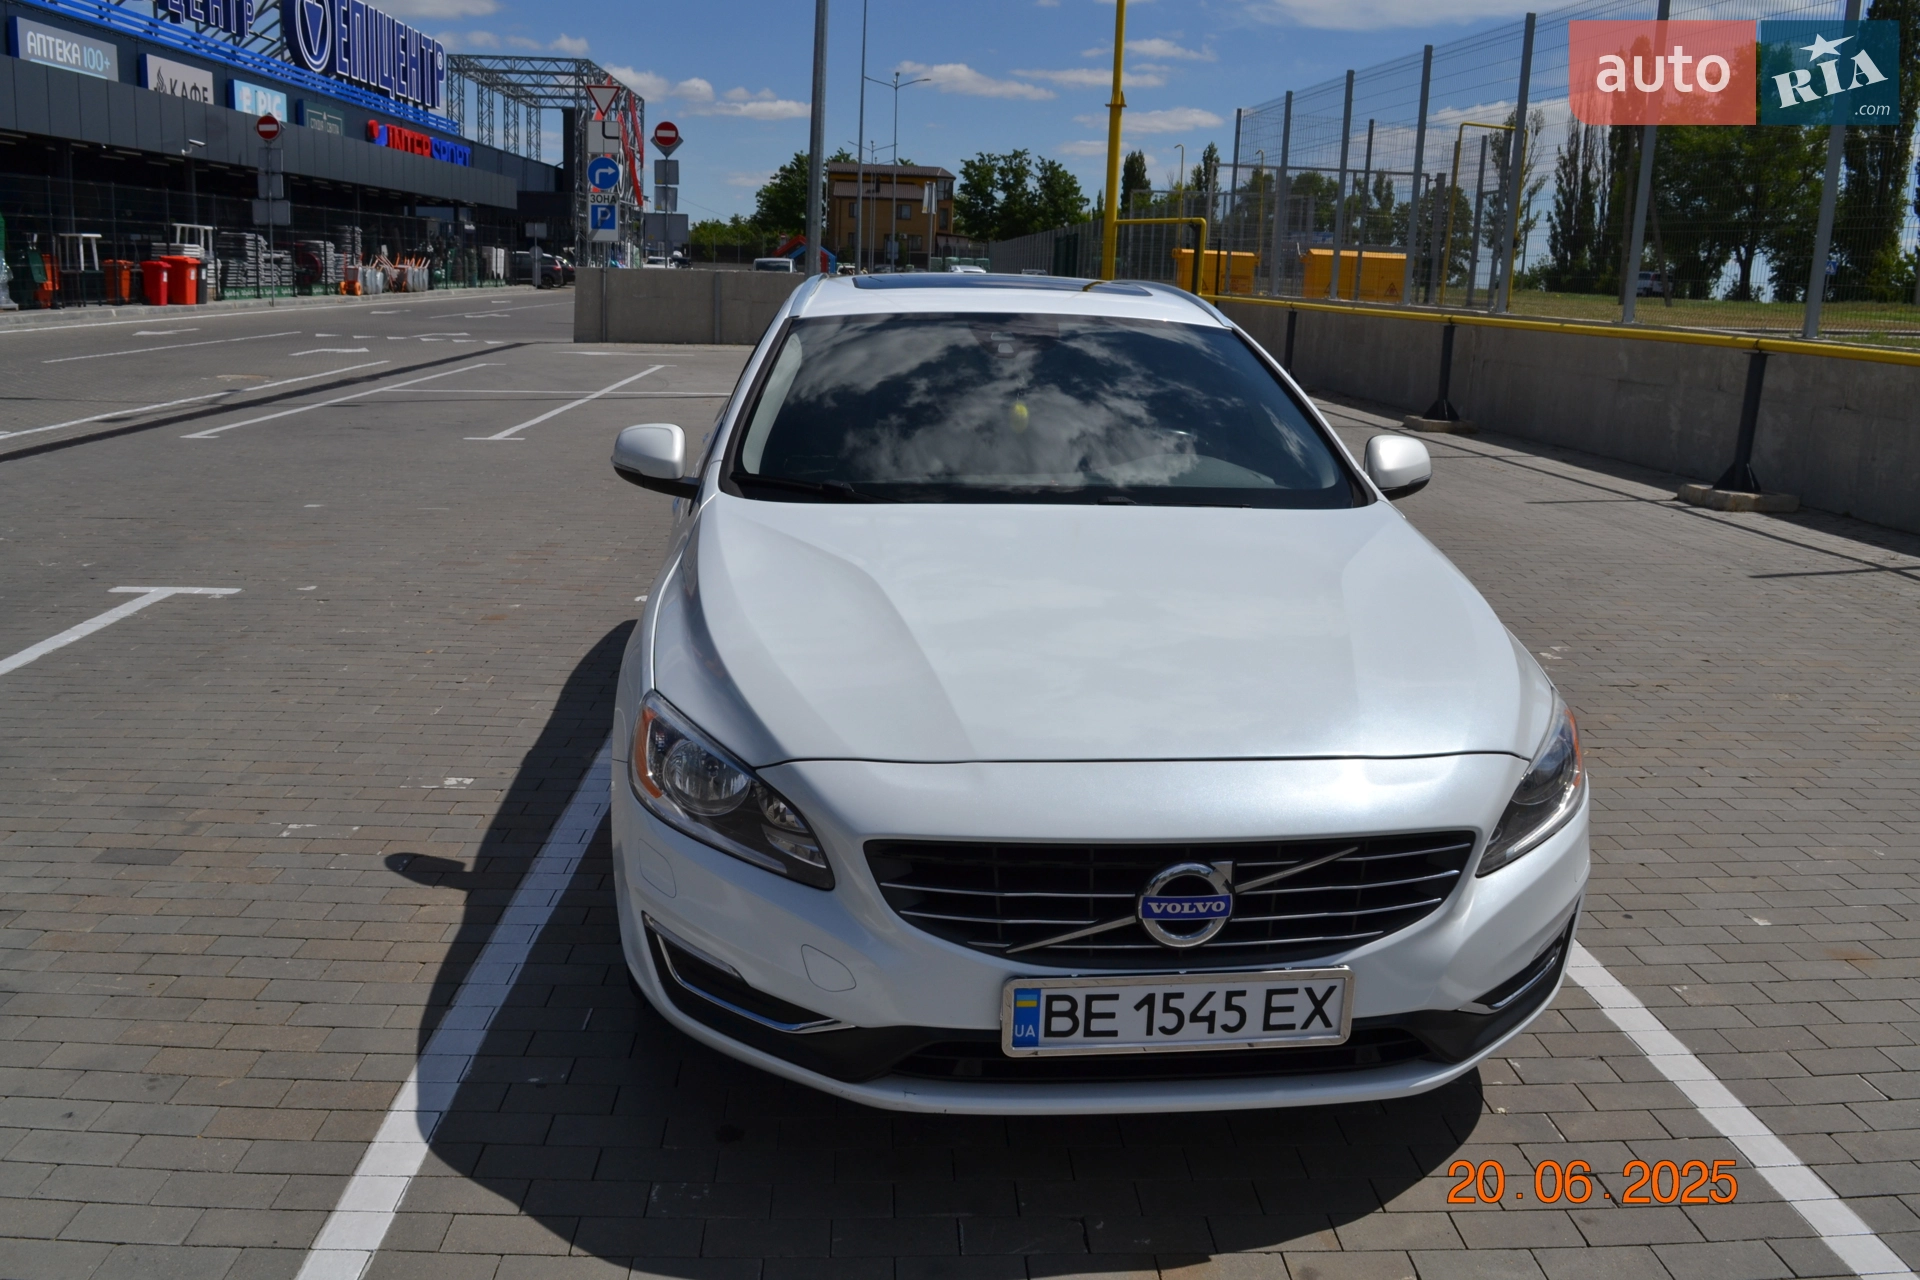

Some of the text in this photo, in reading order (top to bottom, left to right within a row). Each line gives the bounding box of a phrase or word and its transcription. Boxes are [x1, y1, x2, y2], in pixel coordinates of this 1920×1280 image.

[27, 31, 111, 72] АПТЕКА 100+
[335, 0, 446, 109] ЕПІЦЕНТР
[169, 77, 209, 103] КАФЕ
[590, 194, 617, 204] ЗОНА
[1148, 900, 1226, 914] VOLVO
[1043, 985, 1338, 1038] BE 1545 EX
[1014, 1024, 1036, 1038] UA
